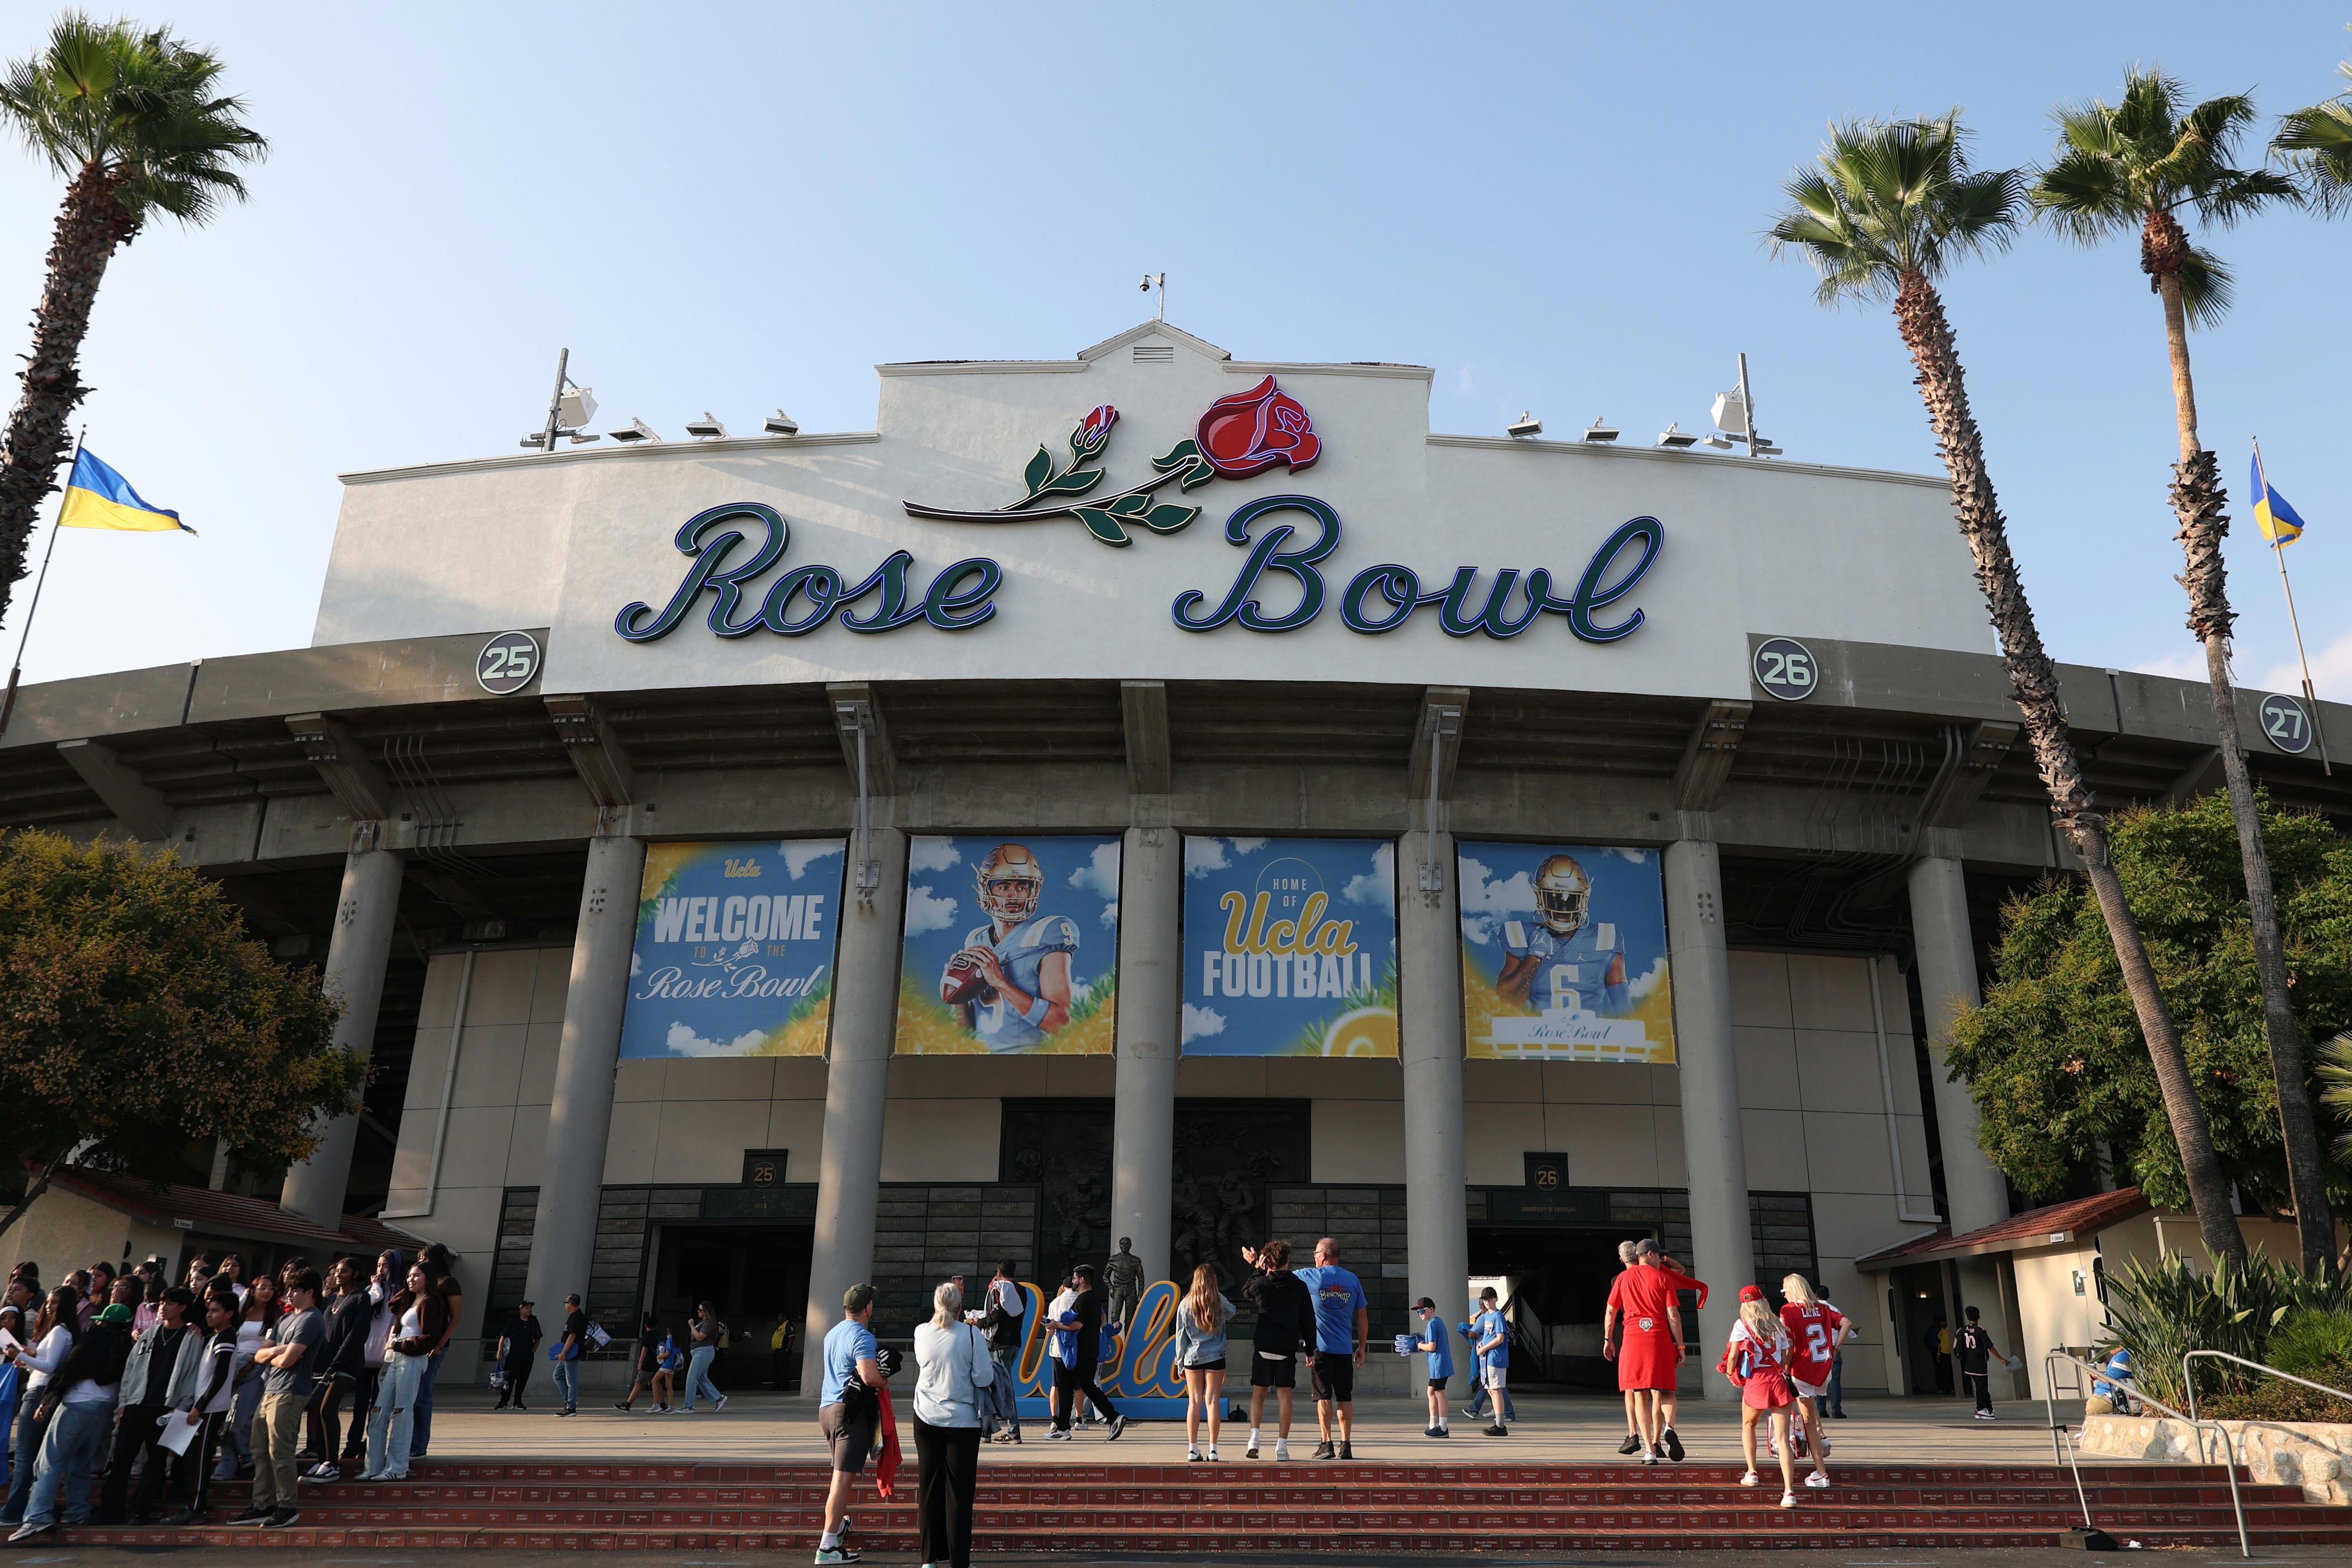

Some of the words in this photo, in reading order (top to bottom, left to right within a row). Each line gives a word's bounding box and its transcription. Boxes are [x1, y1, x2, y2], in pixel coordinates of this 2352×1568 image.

[615, 502, 1003, 644] Rose
[1171, 494, 1665, 645] Bowl
[481, 645, 533, 680] 25
[1761, 652, 1811, 686] 26
[2265, 706, 2302, 739] 27
[725, 858, 762, 878] Ucla
[1273, 879, 1307, 890] HOME
[1283, 895, 1297, 907] OF
[653, 895, 824, 943] WELCOME
[1220, 891, 1358, 958] Ucla
[694, 946, 706, 958] TO
[767, 944, 786, 957] THE
[636, 966, 724, 999] Rose
[721, 965, 825, 999] Bowl
[1203, 951, 1377, 999] FOOTBALL
[1550, 965, 1581, 1010] 6
[1566, 1025, 1612, 1040] Bowl
[753, 1167, 774, 1182] 25
[1538, 1171, 1557, 1184] 26
[1806, 1323, 1832, 1362] 2
